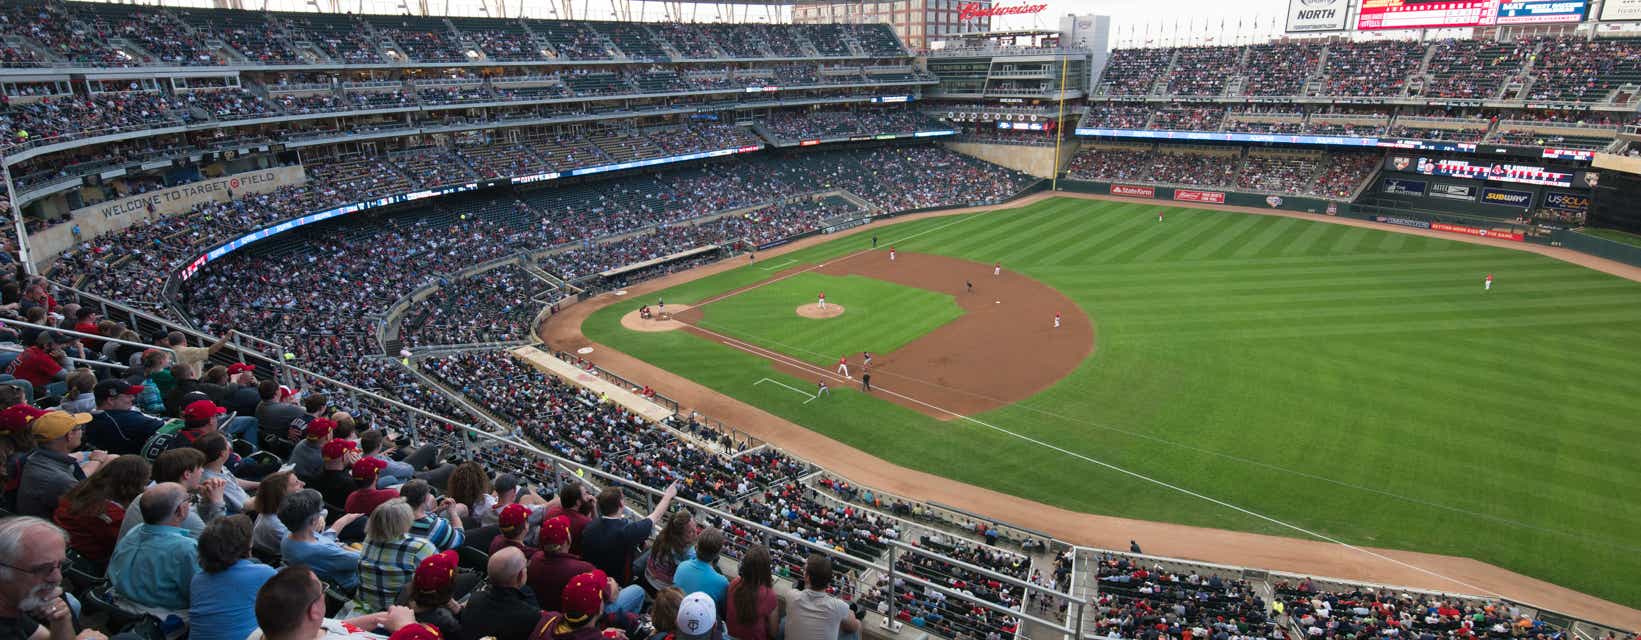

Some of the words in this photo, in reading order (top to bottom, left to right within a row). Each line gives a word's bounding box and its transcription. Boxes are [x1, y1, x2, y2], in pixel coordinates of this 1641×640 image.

[957, 1, 1048, 20] Budweiser
[1297, 9, 1336, 20] NORTH
[101, 194, 162, 219] WELCOME
[163, 190, 182, 202] TO
[183, 181, 228, 197] TARGET
[240, 172, 275, 186] FIELD
[1486, 192, 1528, 203] SUBWAY
